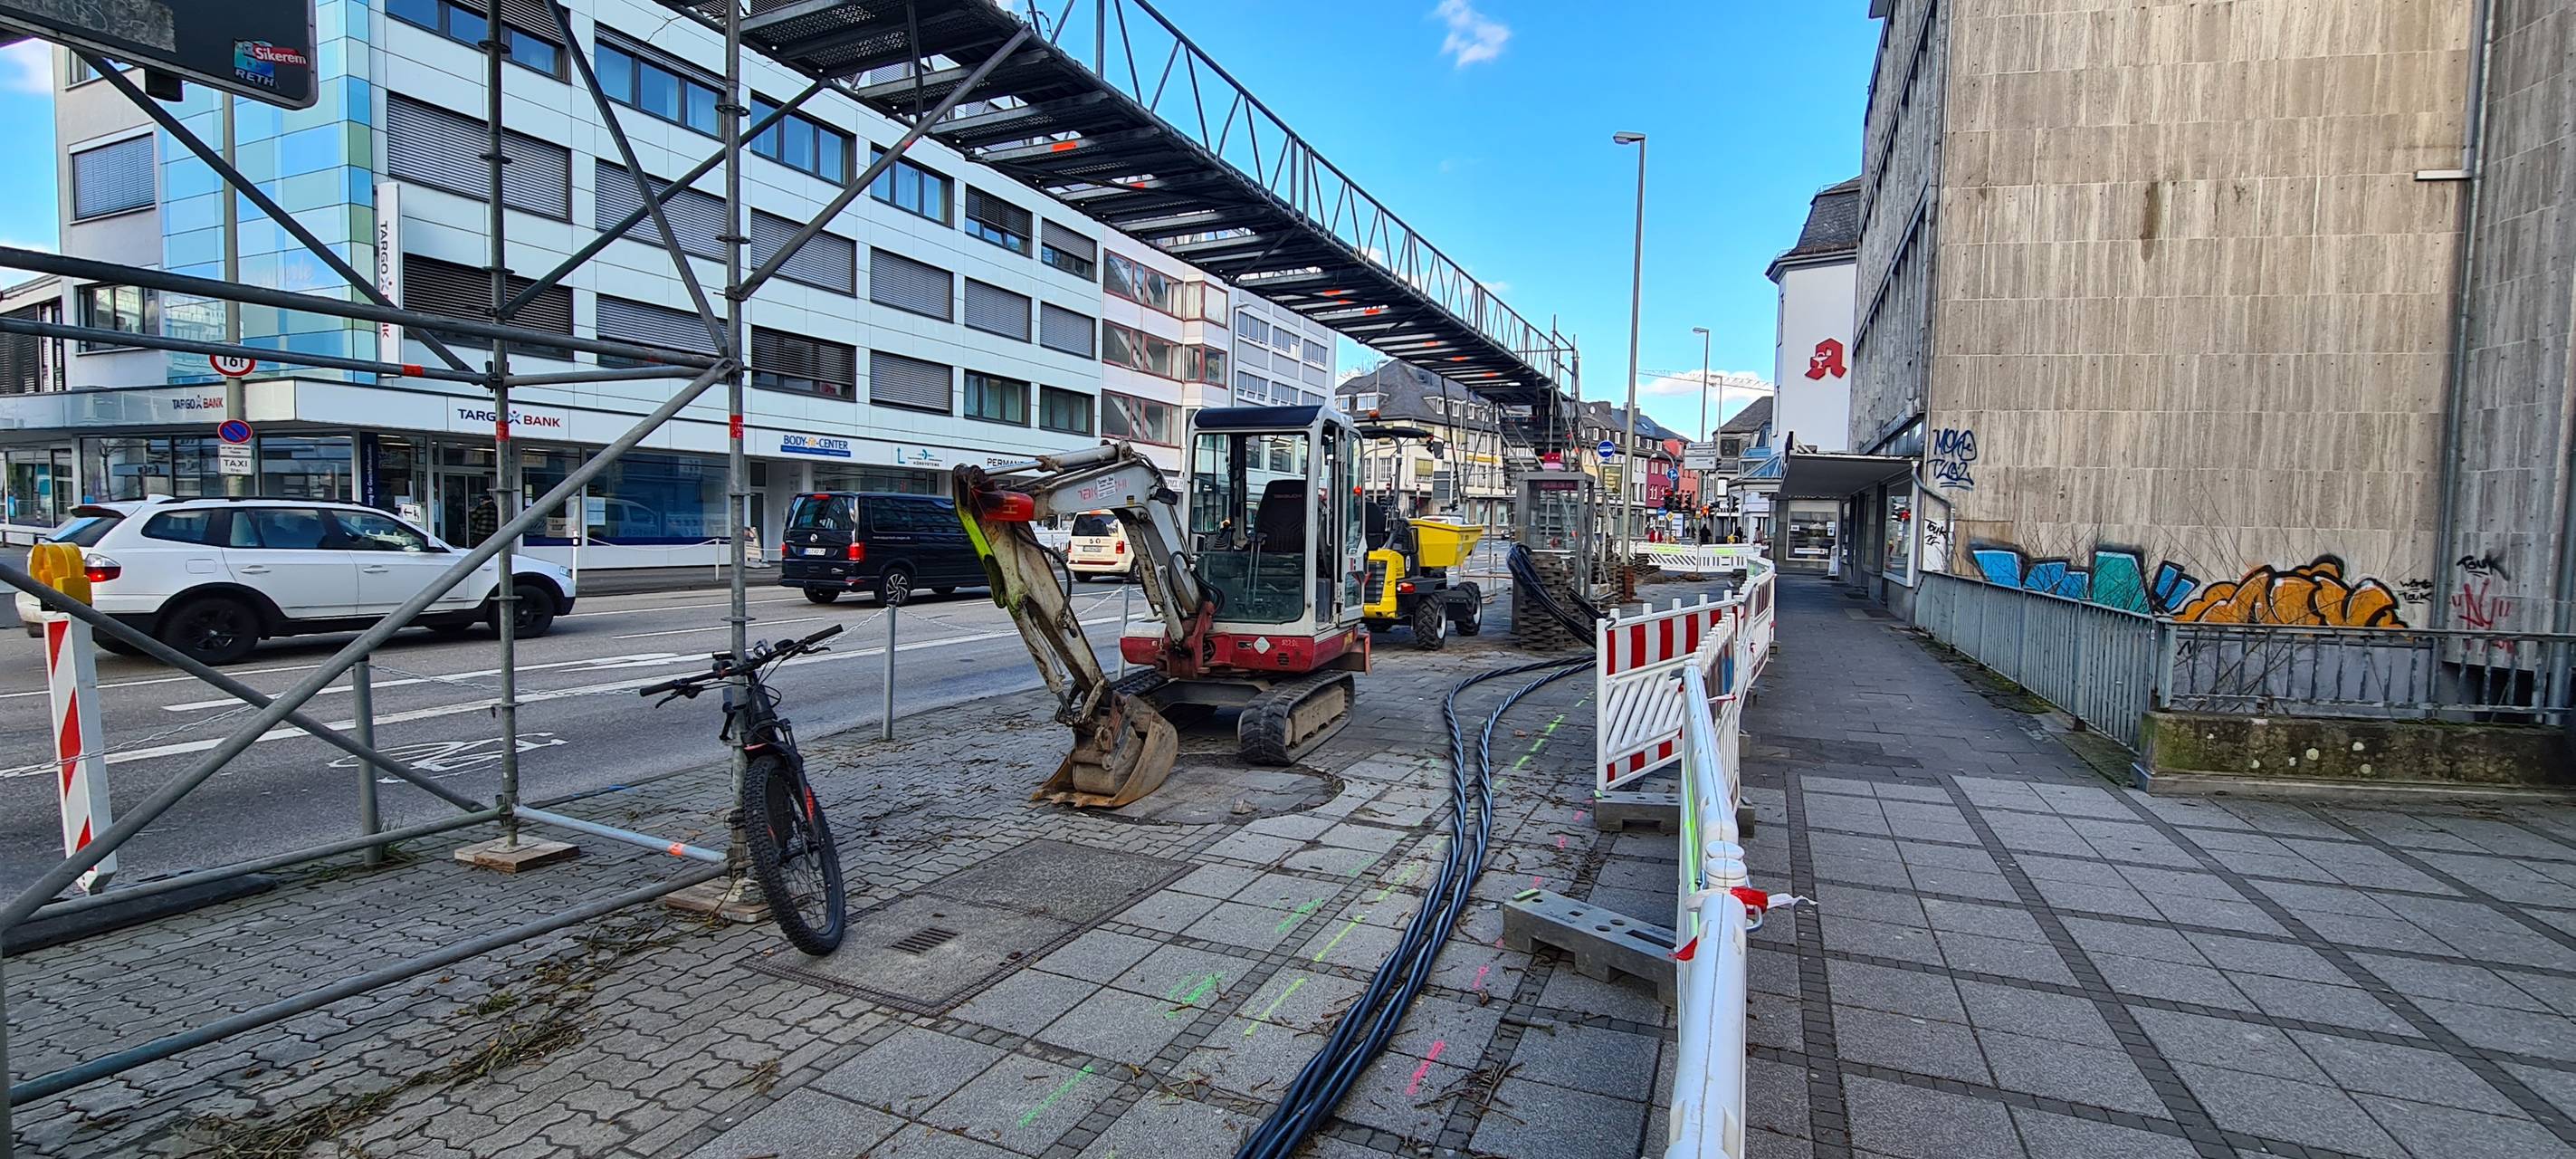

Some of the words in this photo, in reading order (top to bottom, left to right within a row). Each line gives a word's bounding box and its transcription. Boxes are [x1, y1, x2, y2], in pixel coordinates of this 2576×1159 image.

[254, 46, 307, 64] Sikerem
[380, 220, 388, 274] TARGO
[204, 398, 224, 408] BANK
[457, 408, 497, 422] TARG
[523, 415, 561, 428] BANK
[224, 459, 248, 467] TAXI
